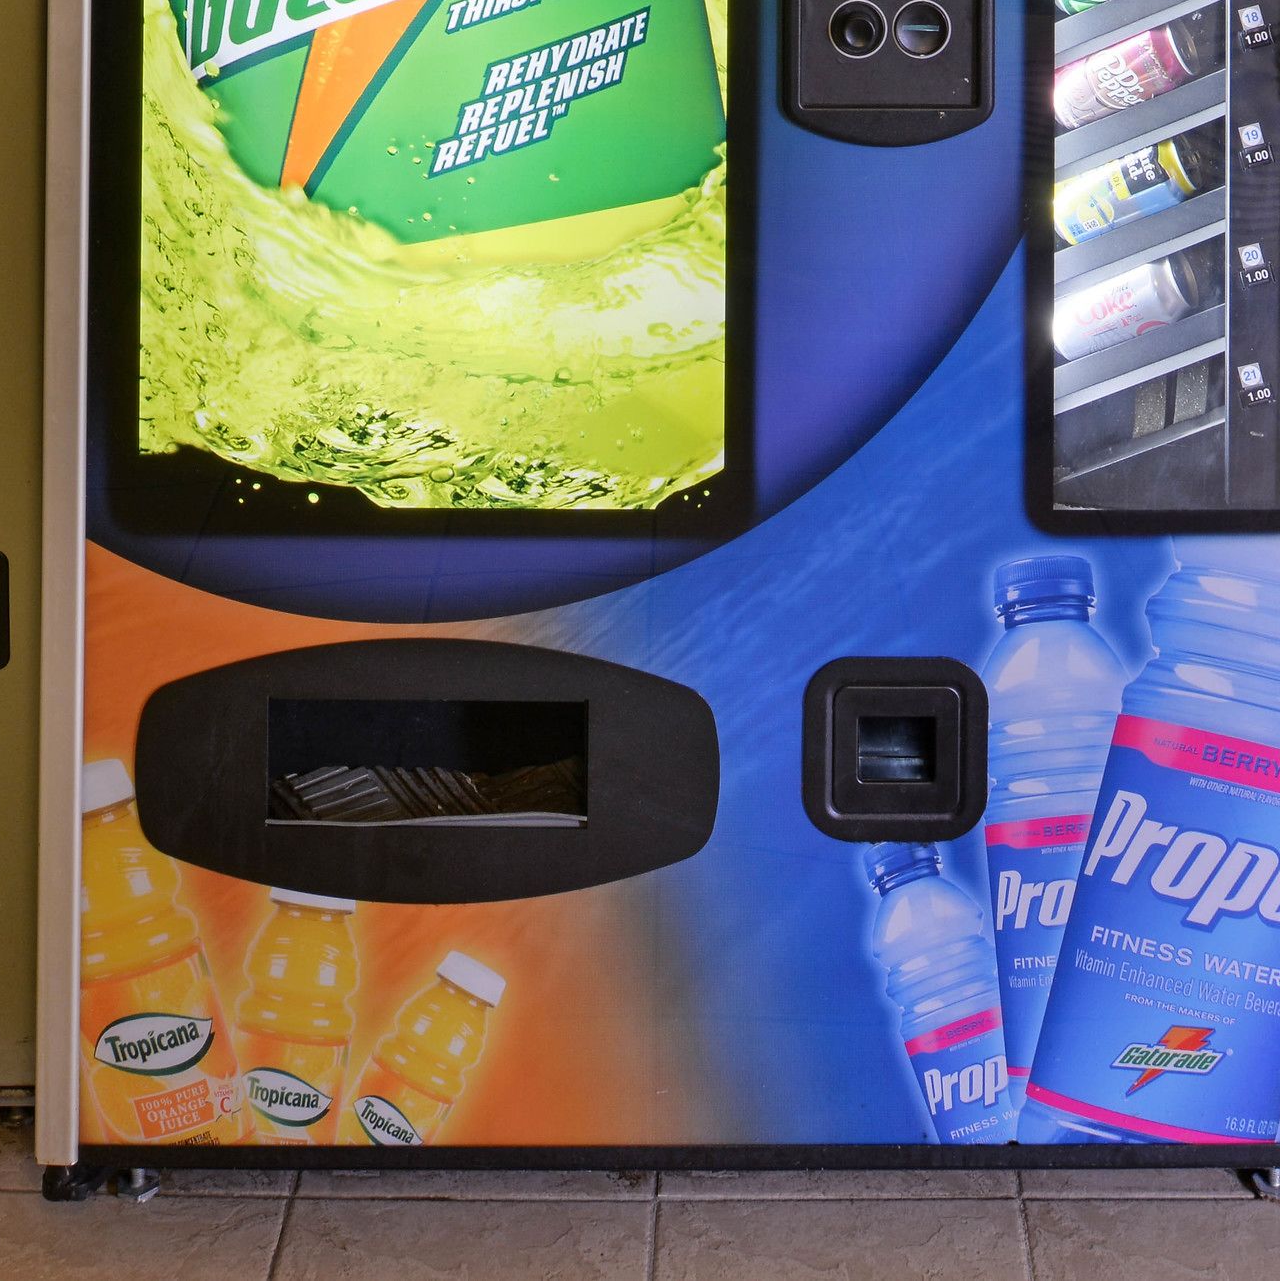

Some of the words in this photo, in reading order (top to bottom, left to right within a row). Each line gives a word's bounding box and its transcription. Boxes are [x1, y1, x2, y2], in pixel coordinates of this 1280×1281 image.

[488, 12, 646, 95] REHYDRATE
[460, 52, 626, 136] REPLENISH
[1154, 737, 1199, 755] NATURAL
[1091, 925, 1193, 967] FITNESS
[1075, 948, 1116, 979] Vitamin
[1120, 961, 1194, 998] Enhanced
[1198, 980, 1241, 1008] Water
[1124, 993, 1154, 1007] FROM
[1156, 1001, 1175, 1012] THE
[1178, 1006, 1221, 1023] MAKERS
[1223, 1017, 1236, 1026] OF
[105, 1020, 200, 1063] Tropicana
[1119, 1045, 1220, 1072] Gatorade
[140, 1098, 173, 1112] 100%
[175, 1084, 207, 1101] PURE
[247, 1075, 320, 1109] Tropicana
[146, 1097, 207, 1123] ORANGE
[159, 1110, 201, 1134] JUICE
[360, 1098, 416, 1145] Tropicana
[1224, 1116, 1246, 1133] 16.9
[1248, 1119, 1258, 1134] FL
[1257, 1120, 1268, 1135] OZ
